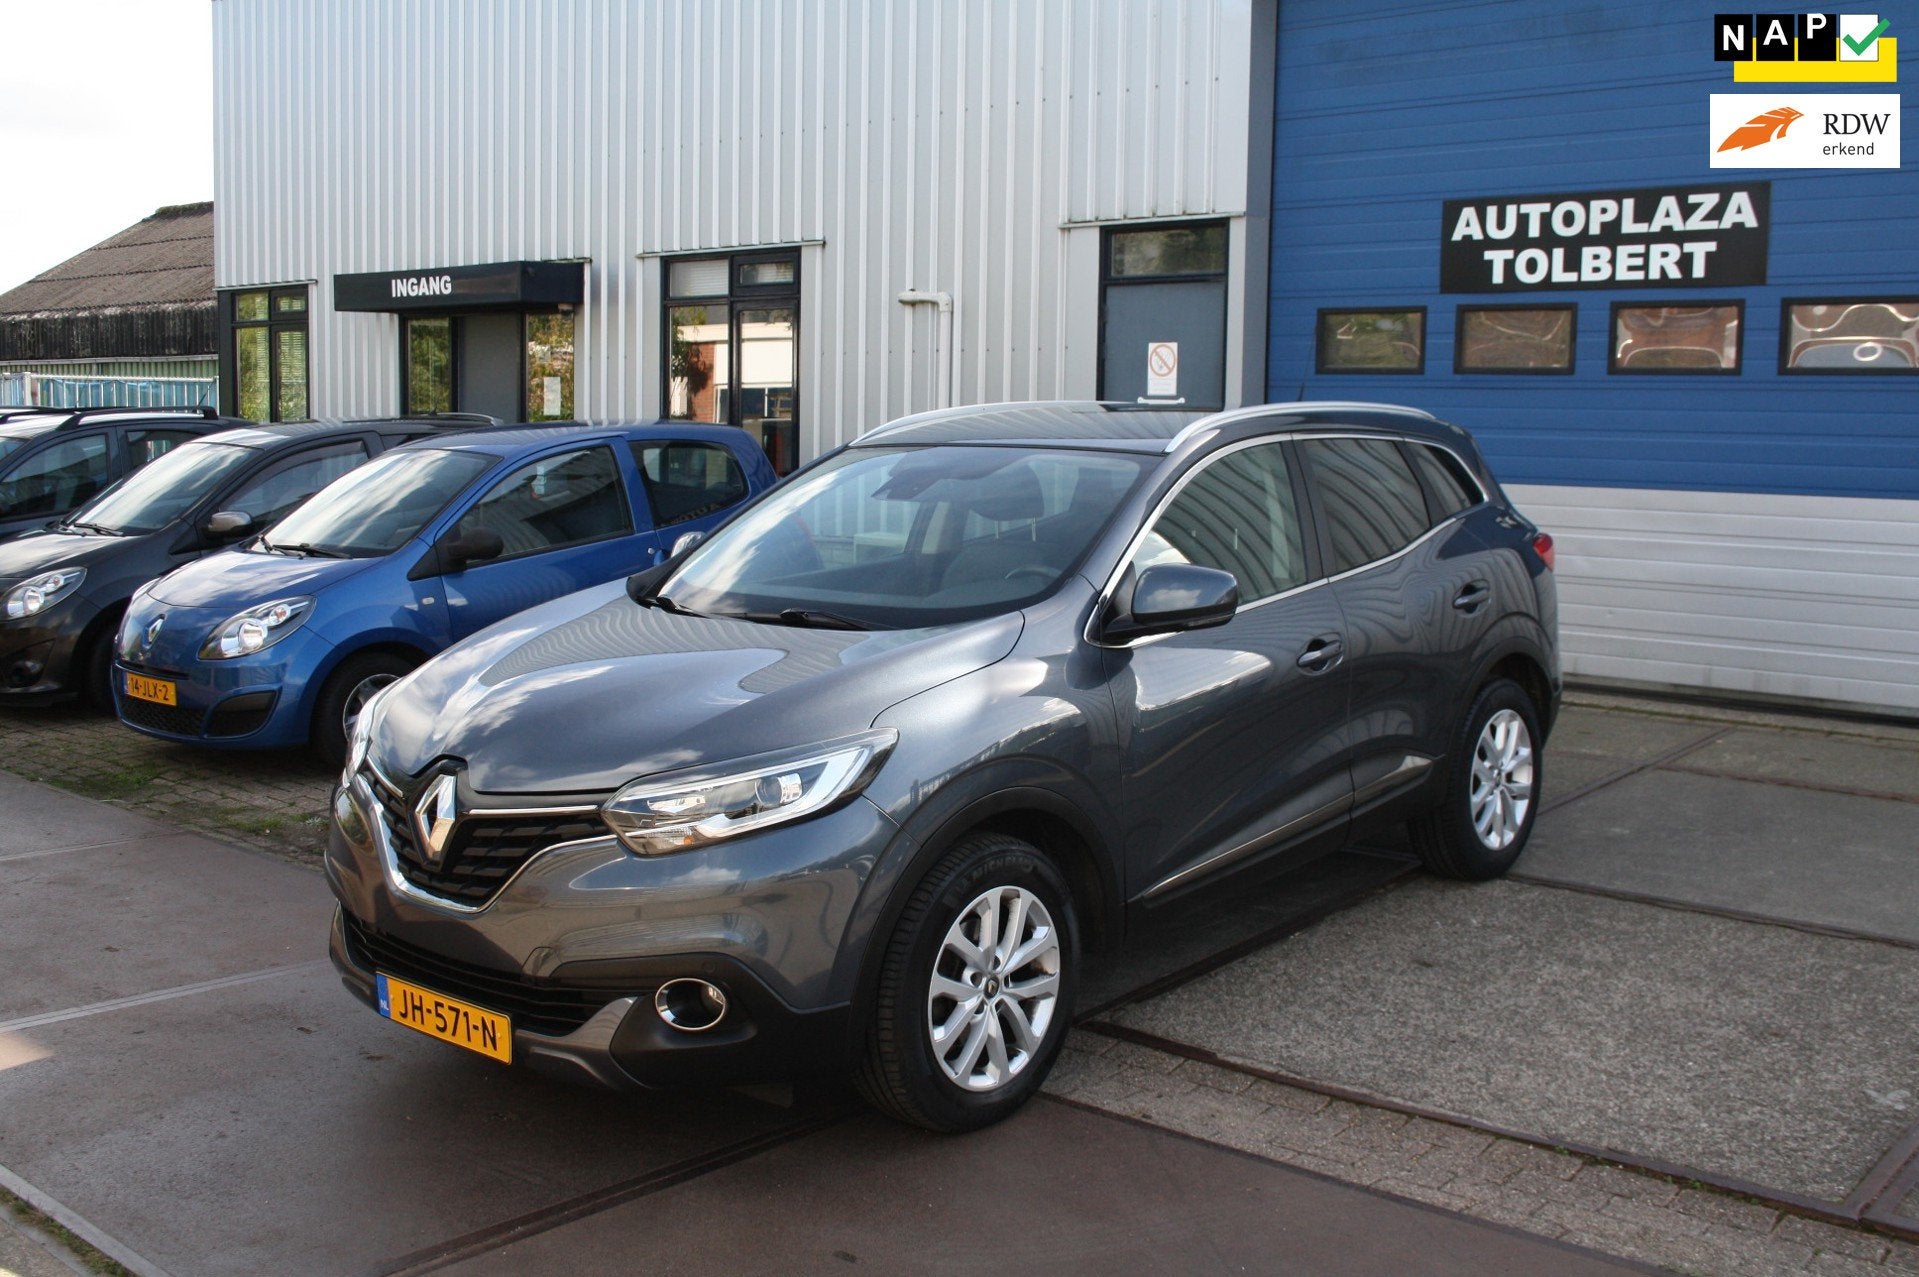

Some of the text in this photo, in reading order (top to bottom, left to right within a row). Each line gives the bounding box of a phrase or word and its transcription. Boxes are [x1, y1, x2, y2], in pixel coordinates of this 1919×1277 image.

[1451, 191, 1758, 241] AUTOPLAZA
[1483, 241, 1717, 284] TOLBERT
[391, 275, 452, 297] INGANG
[130, 677, 169, 701] 14-JLX-2
[399, 989, 498, 1051] JH-571-N
